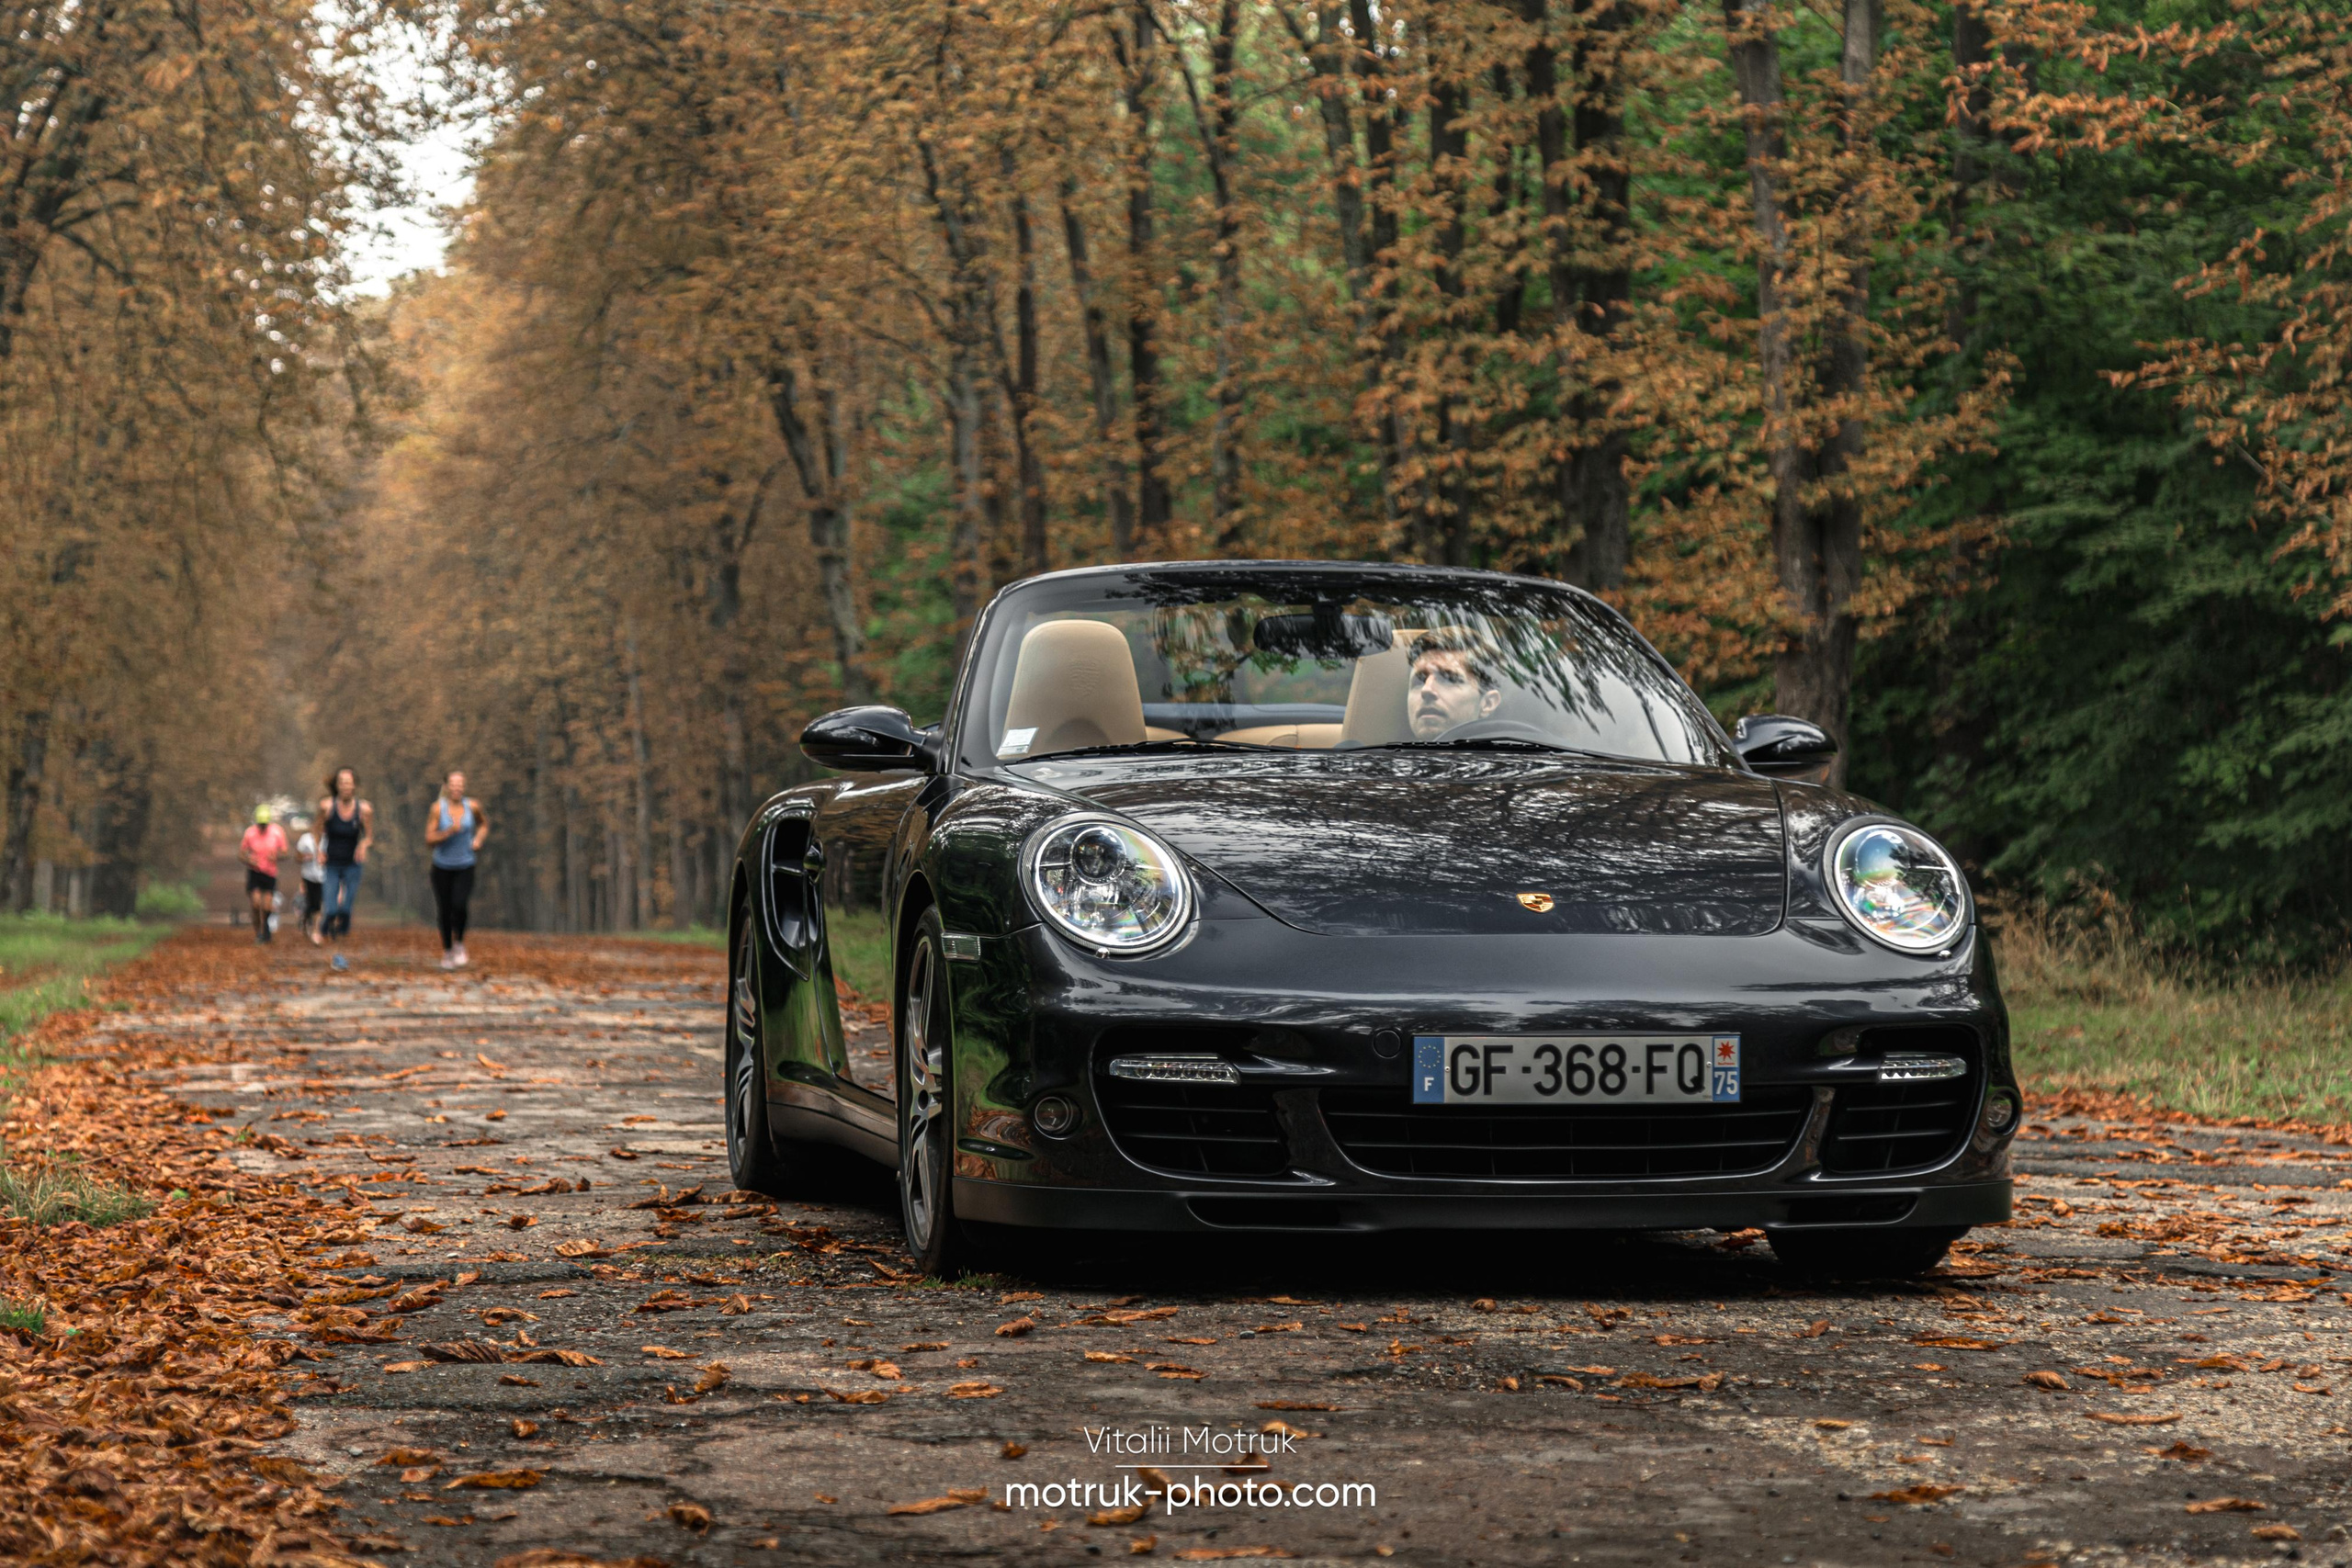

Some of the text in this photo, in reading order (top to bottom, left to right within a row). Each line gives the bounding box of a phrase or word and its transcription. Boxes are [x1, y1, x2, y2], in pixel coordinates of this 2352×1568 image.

[1450, 1043, 1705, 1096] GF-368-FQ
[1424, 1077, 1434, 1091] F
[1714, 1071, 1738, 1094] 75
